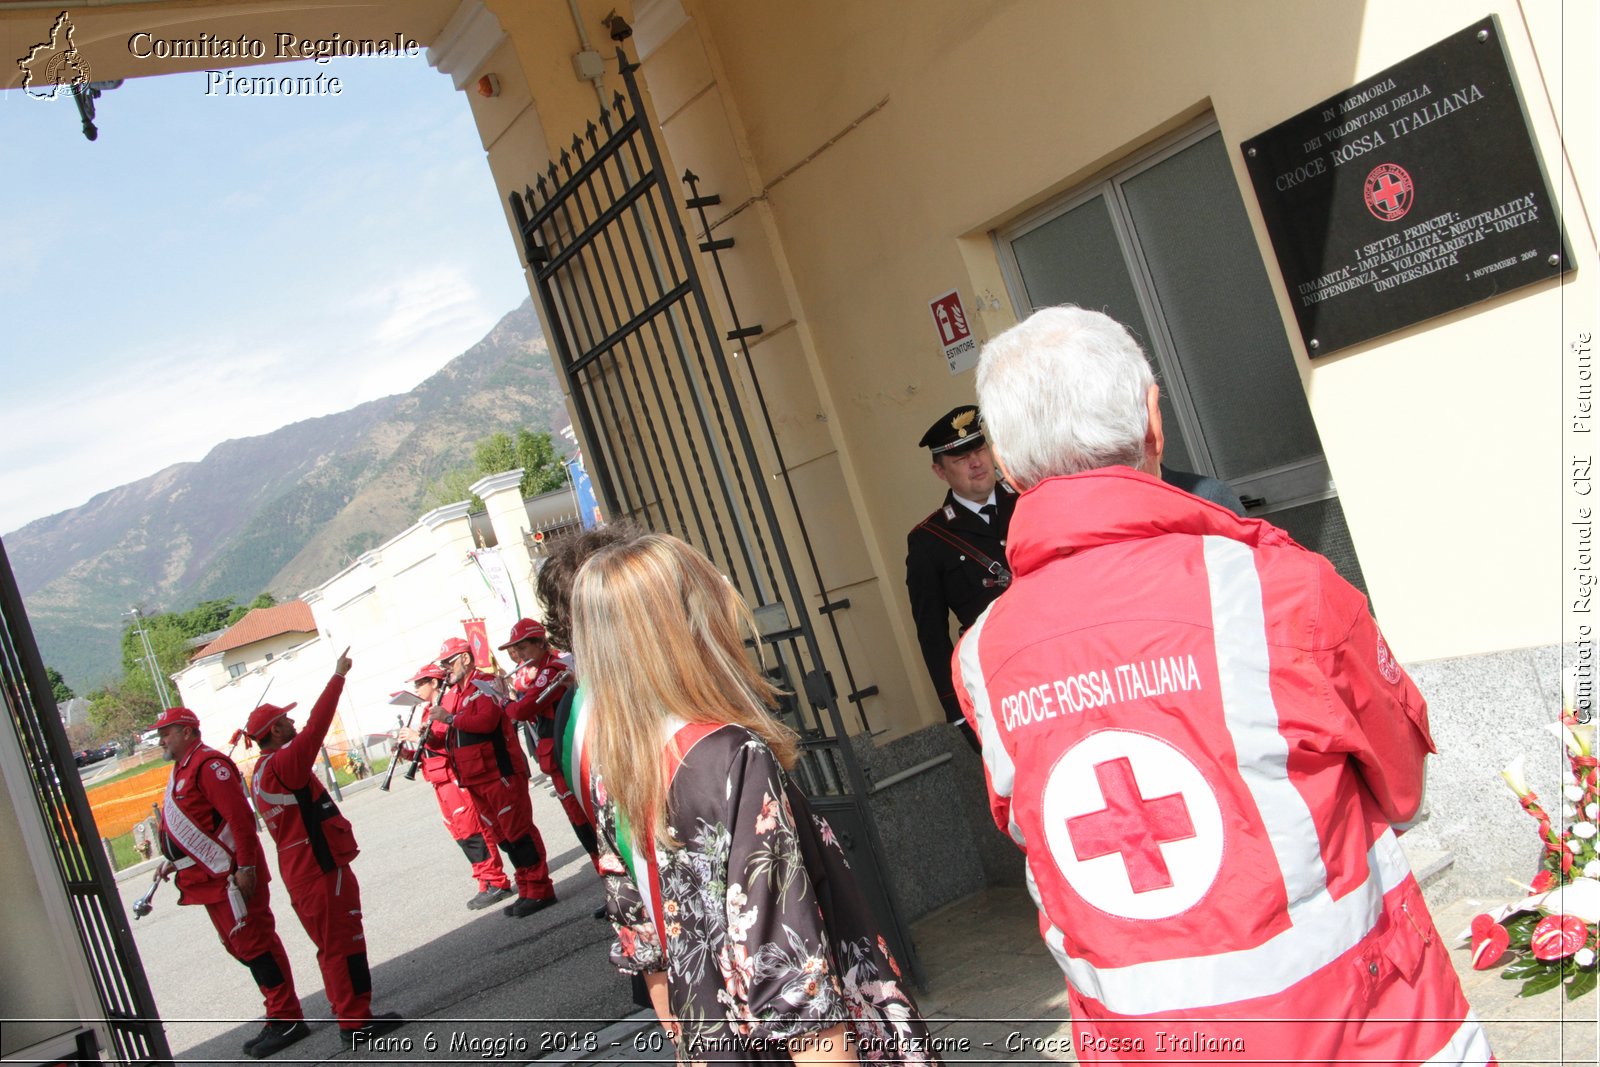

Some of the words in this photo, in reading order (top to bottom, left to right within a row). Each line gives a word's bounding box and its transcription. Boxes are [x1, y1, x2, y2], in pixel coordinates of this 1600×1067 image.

[1303, 136, 1323, 154] DEI
[1324, 104, 1390, 142] VOLONTARI
[1392, 84, 1432, 112] DELLA
[1322, 110, 1337, 123] IN
[1339, 78, 1397, 114] MEMORIA
[1276, 157, 1327, 192] CROCE
[1330, 130, 1387, 168] ROSSA
[1389, 84, 1485, 140] ITALIANA
[1354, 249, 1362, 260] I
[1363, 233, 1400, 256] SETTE
[1465, 272, 1472, 282] 1
[1473, 256, 1518, 278] NOVEMBRE
[1520, 249, 1538, 263] 2006
[1302, 270, 1378, 307] INDIPENDENZA
[946, 340, 976, 360] ESTINTORE
[1001, 683, 1057, 732] CROCE
[1054, 669, 1116, 716] ROSSA
[1114, 654, 1202, 702] ITALIANA
[178, 824, 218, 864] ITALIANA
